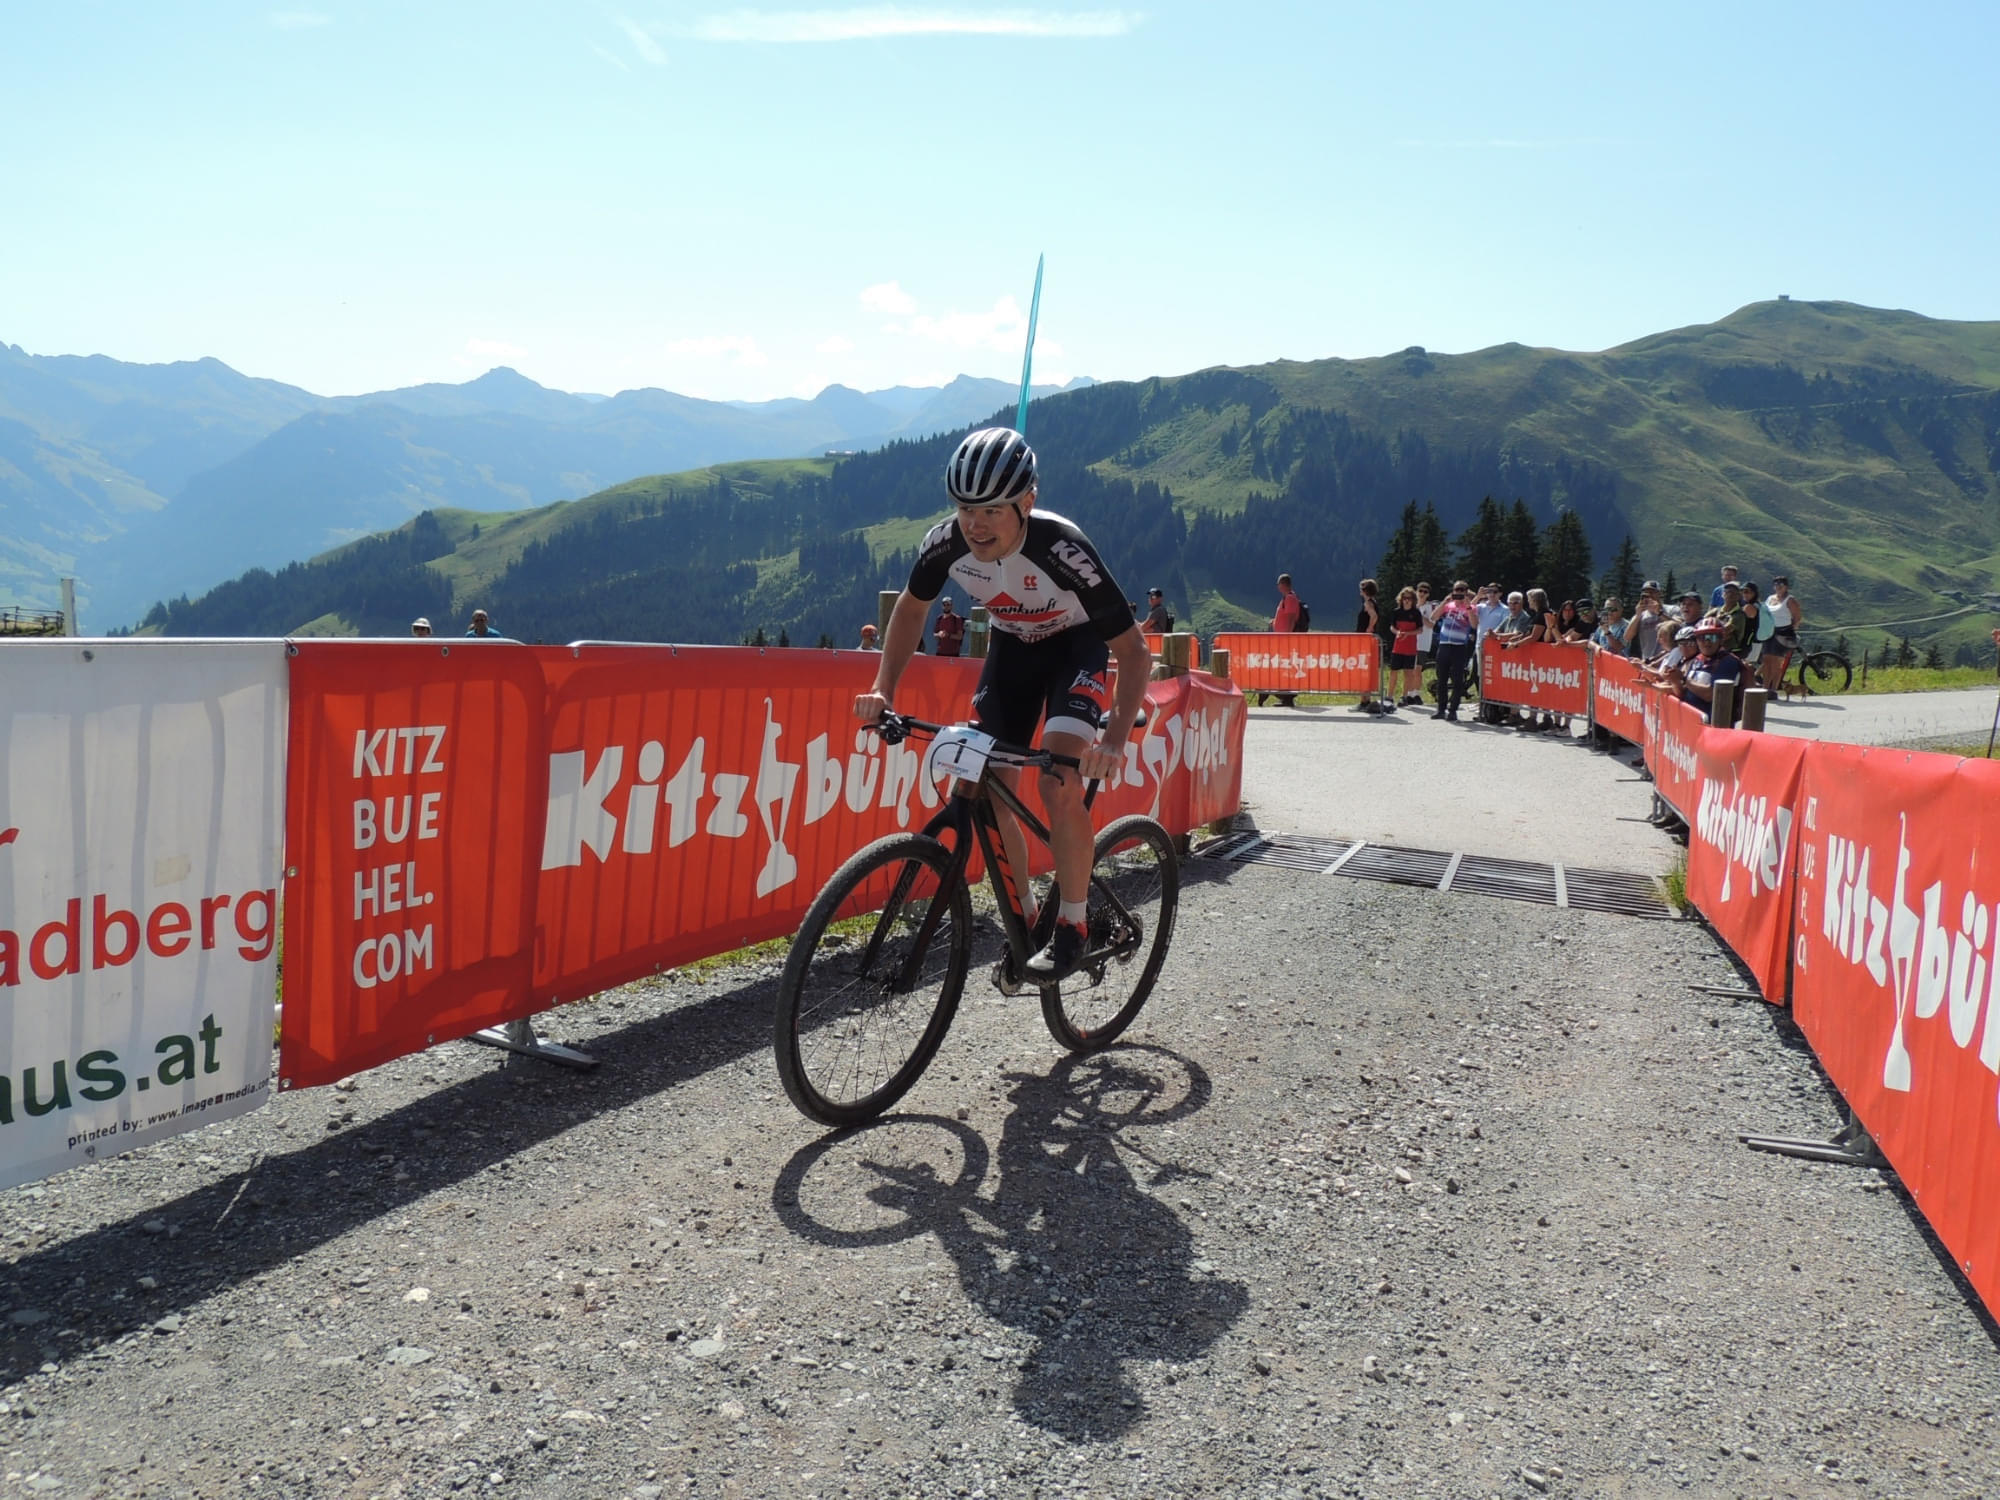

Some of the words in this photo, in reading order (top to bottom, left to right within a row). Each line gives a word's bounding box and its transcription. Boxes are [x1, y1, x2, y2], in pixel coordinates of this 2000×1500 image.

[1050, 540, 1102, 588] KTM
[1247, 652, 1369, 673] Kitzbühel
[1501, 661, 1581, 690] Kitzbühel
[353, 725, 447, 778] KITZ
[954, 737, 968, 764] 1
[353, 792, 441, 850] BUE
[541, 722, 968, 871] Kitzbüh
[353, 861, 434, 921] HEL.
[353, 923, 433, 989] COM
[68, 1122, 117, 1150] printed
[122, 1119, 143, 1134] by:
